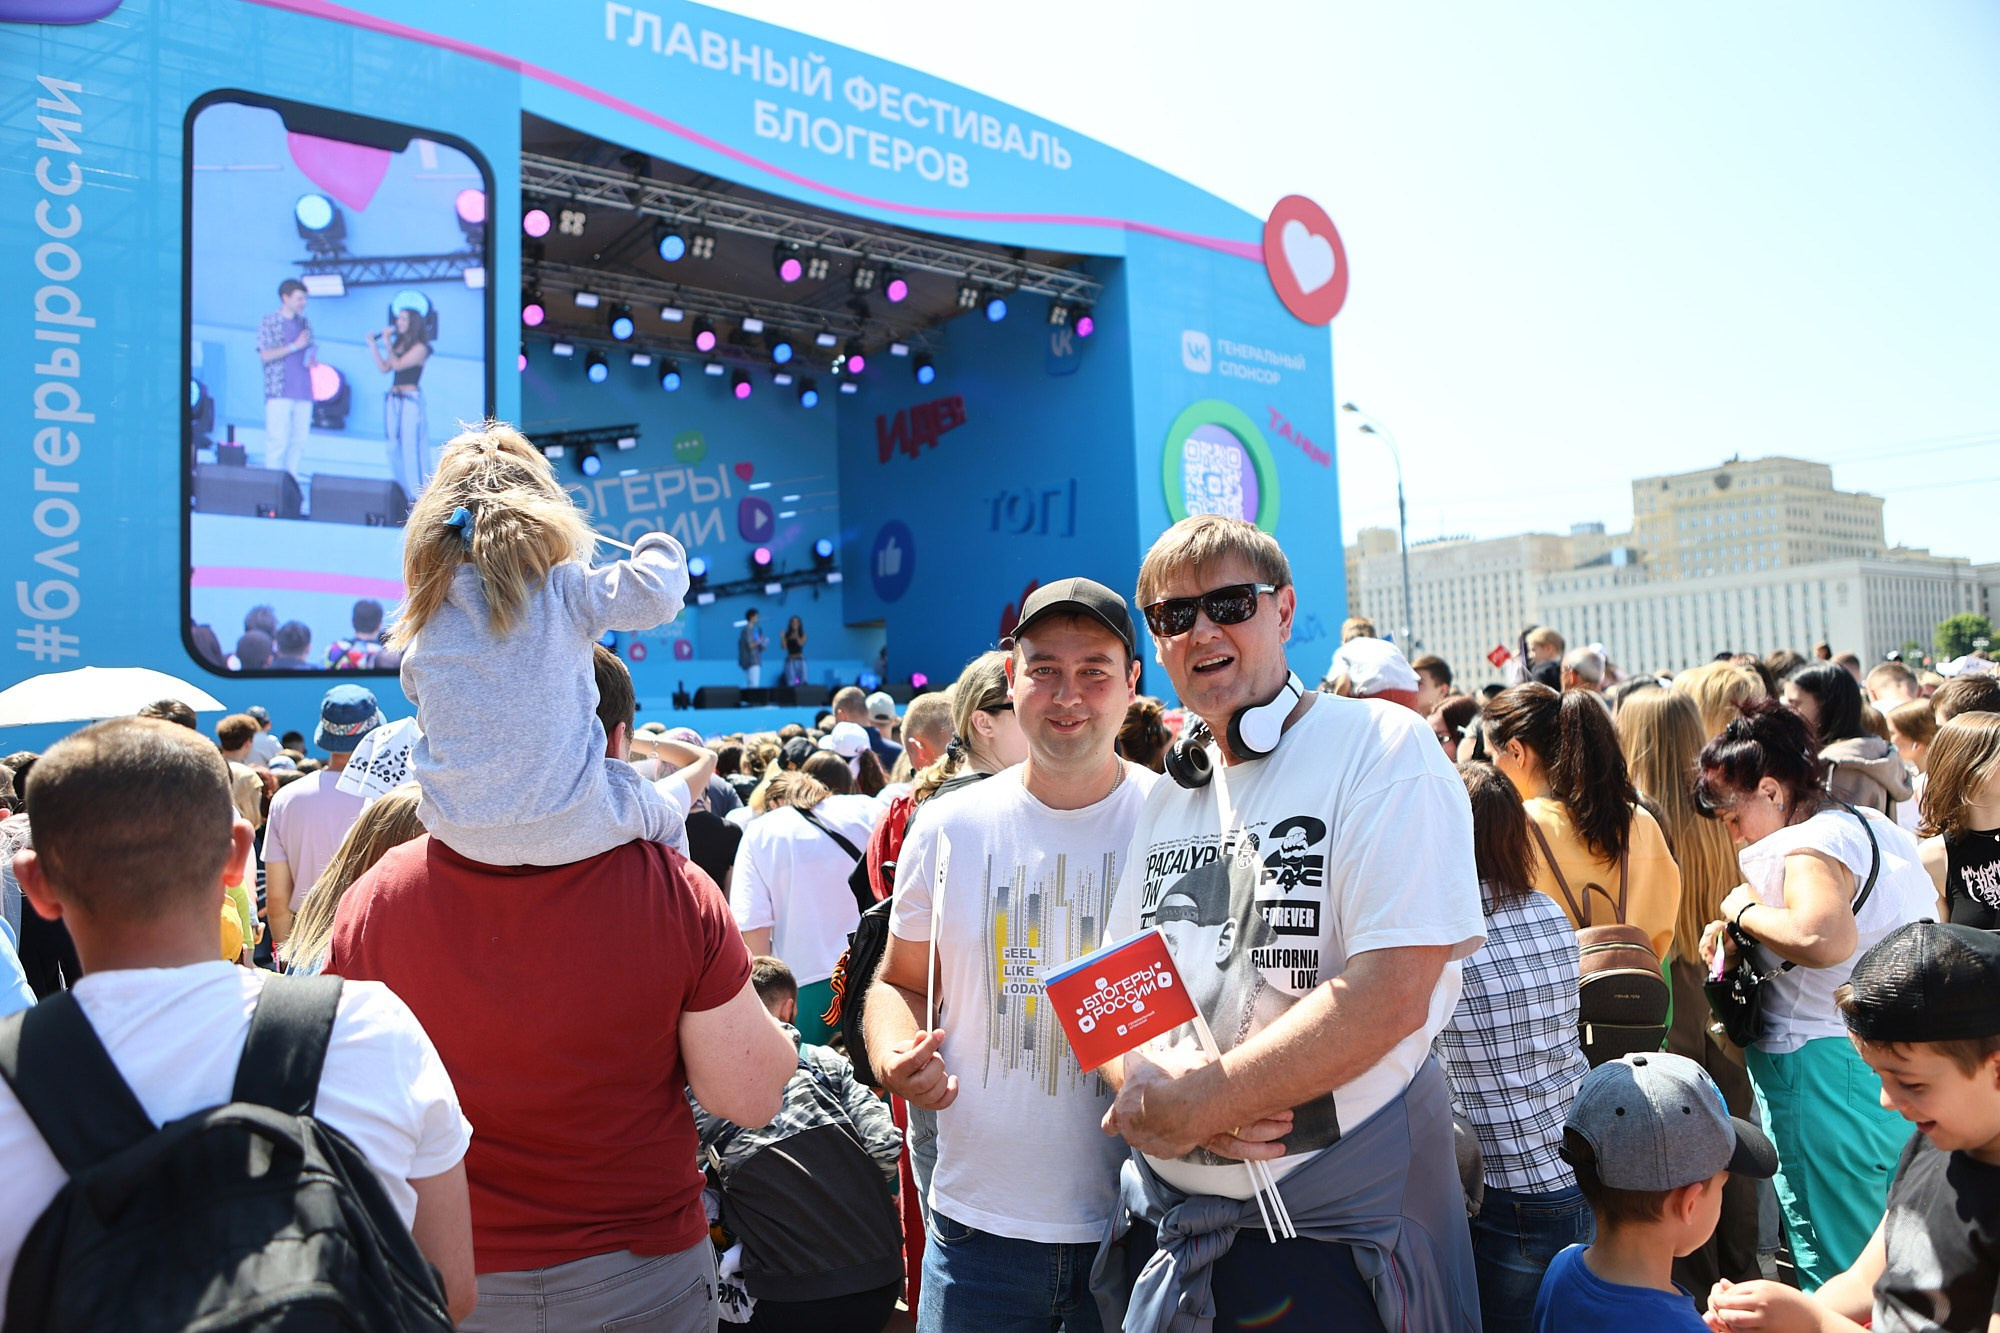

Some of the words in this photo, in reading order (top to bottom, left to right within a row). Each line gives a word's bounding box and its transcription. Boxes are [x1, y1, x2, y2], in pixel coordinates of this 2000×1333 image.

[605, 1, 833, 102] ГЛАВНЫЙ
[843, 75, 1073, 170] ФЕСТИВАЛЬ
[754, 99, 970, 189] БЛОГЕРОВ
[16, 74, 96, 663] #блогерыроссии
[1218, 339, 1306, 371] ГЕНЕРАЛЬНЫЙ
[1219, 360, 1281, 385] СПОНСОР
[1263, 907, 1314, 928] FOREVER
[1004, 965, 1034, 976] LIKE
[1251, 949, 1319, 969] CALIFORNIA
[1082, 965, 1156, 1011] БЛОГЕРЫ
[1291, 970, 1318, 989] LOVE
[1092, 979, 1158, 1021] РОССИИ
